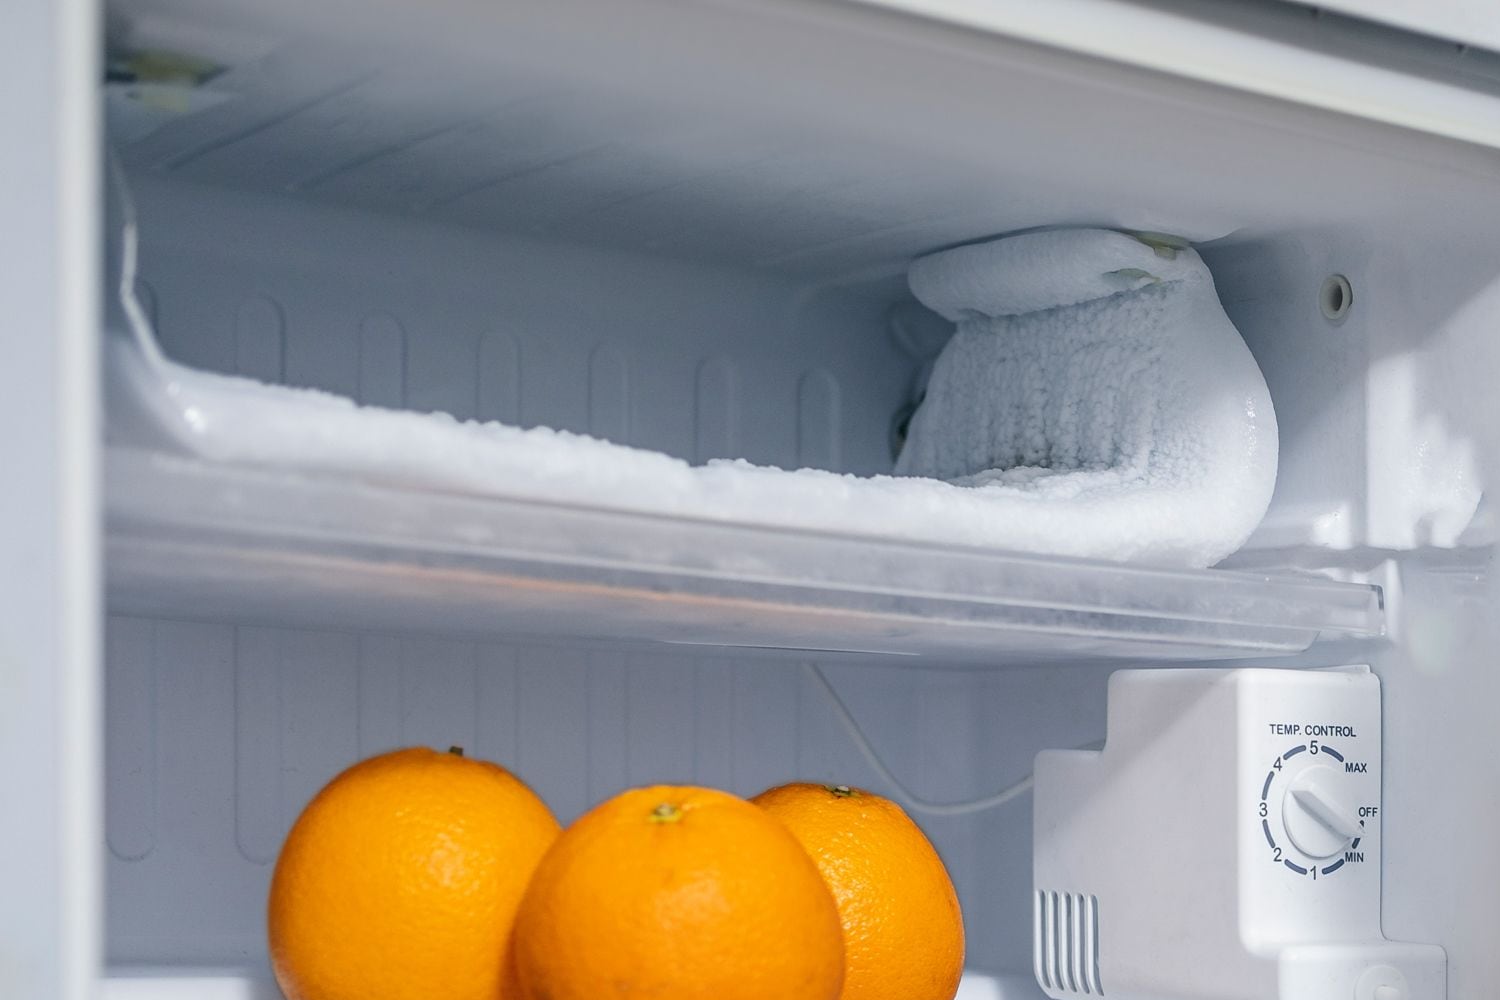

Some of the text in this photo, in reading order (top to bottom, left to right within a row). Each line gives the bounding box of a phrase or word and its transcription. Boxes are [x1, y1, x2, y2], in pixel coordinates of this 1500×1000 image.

[1269, 724, 1357, 737] TEMP. CONTROL
[1309, 740, 1319, 754] 5
[1273, 756, 1282, 771] 4
[1345, 763, 1367, 773] MAX
[1259, 802, 1268, 817] 3
[1358, 807, 1378, 817] OFF
[1273, 848, 1282, 862] 2
[1345, 852, 1364, 862] MIN
[1309, 866, 1317, 880] 1
